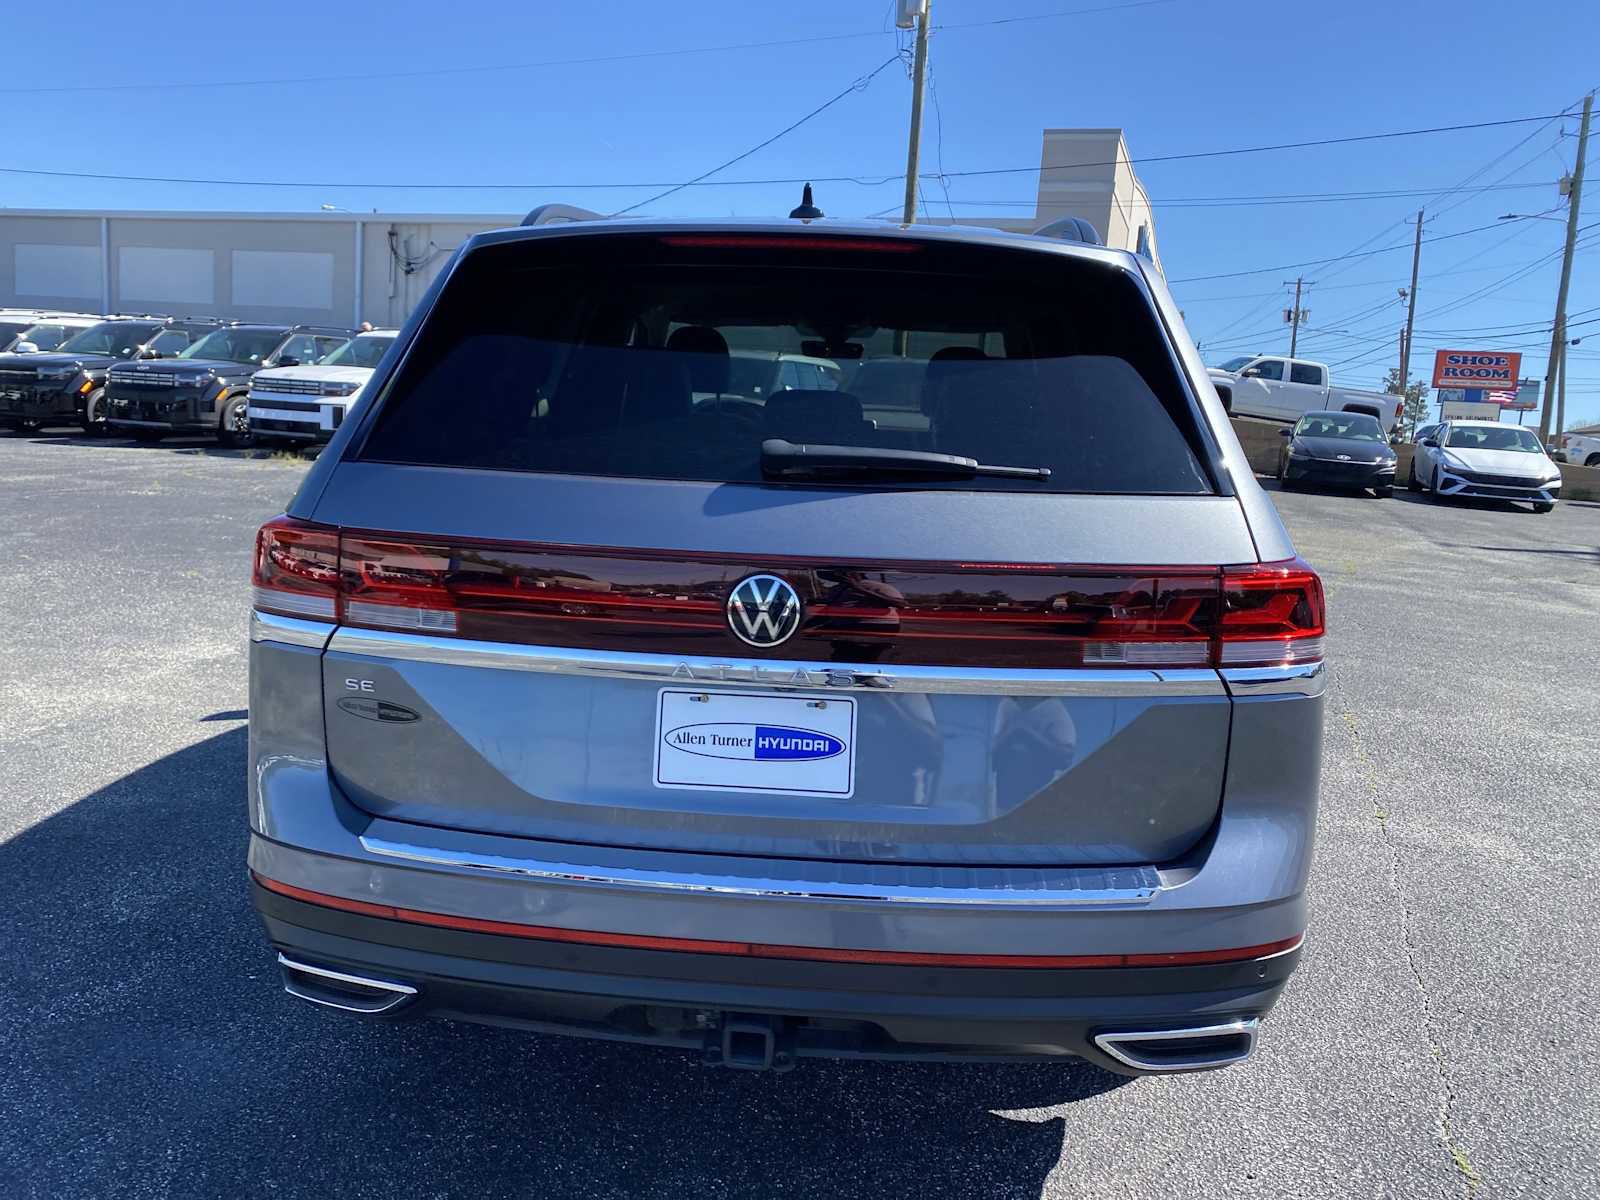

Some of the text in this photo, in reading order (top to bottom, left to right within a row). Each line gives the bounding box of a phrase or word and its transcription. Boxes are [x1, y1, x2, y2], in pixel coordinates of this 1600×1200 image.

[1447, 354, 1508, 366] SHOE
[1443, 367, 1510, 379] ROOM
[672, 662, 856, 687] ATLAS
[345, 678, 375, 692] SE
[673, 731, 829, 752] Allen Turner HYUNDAI
